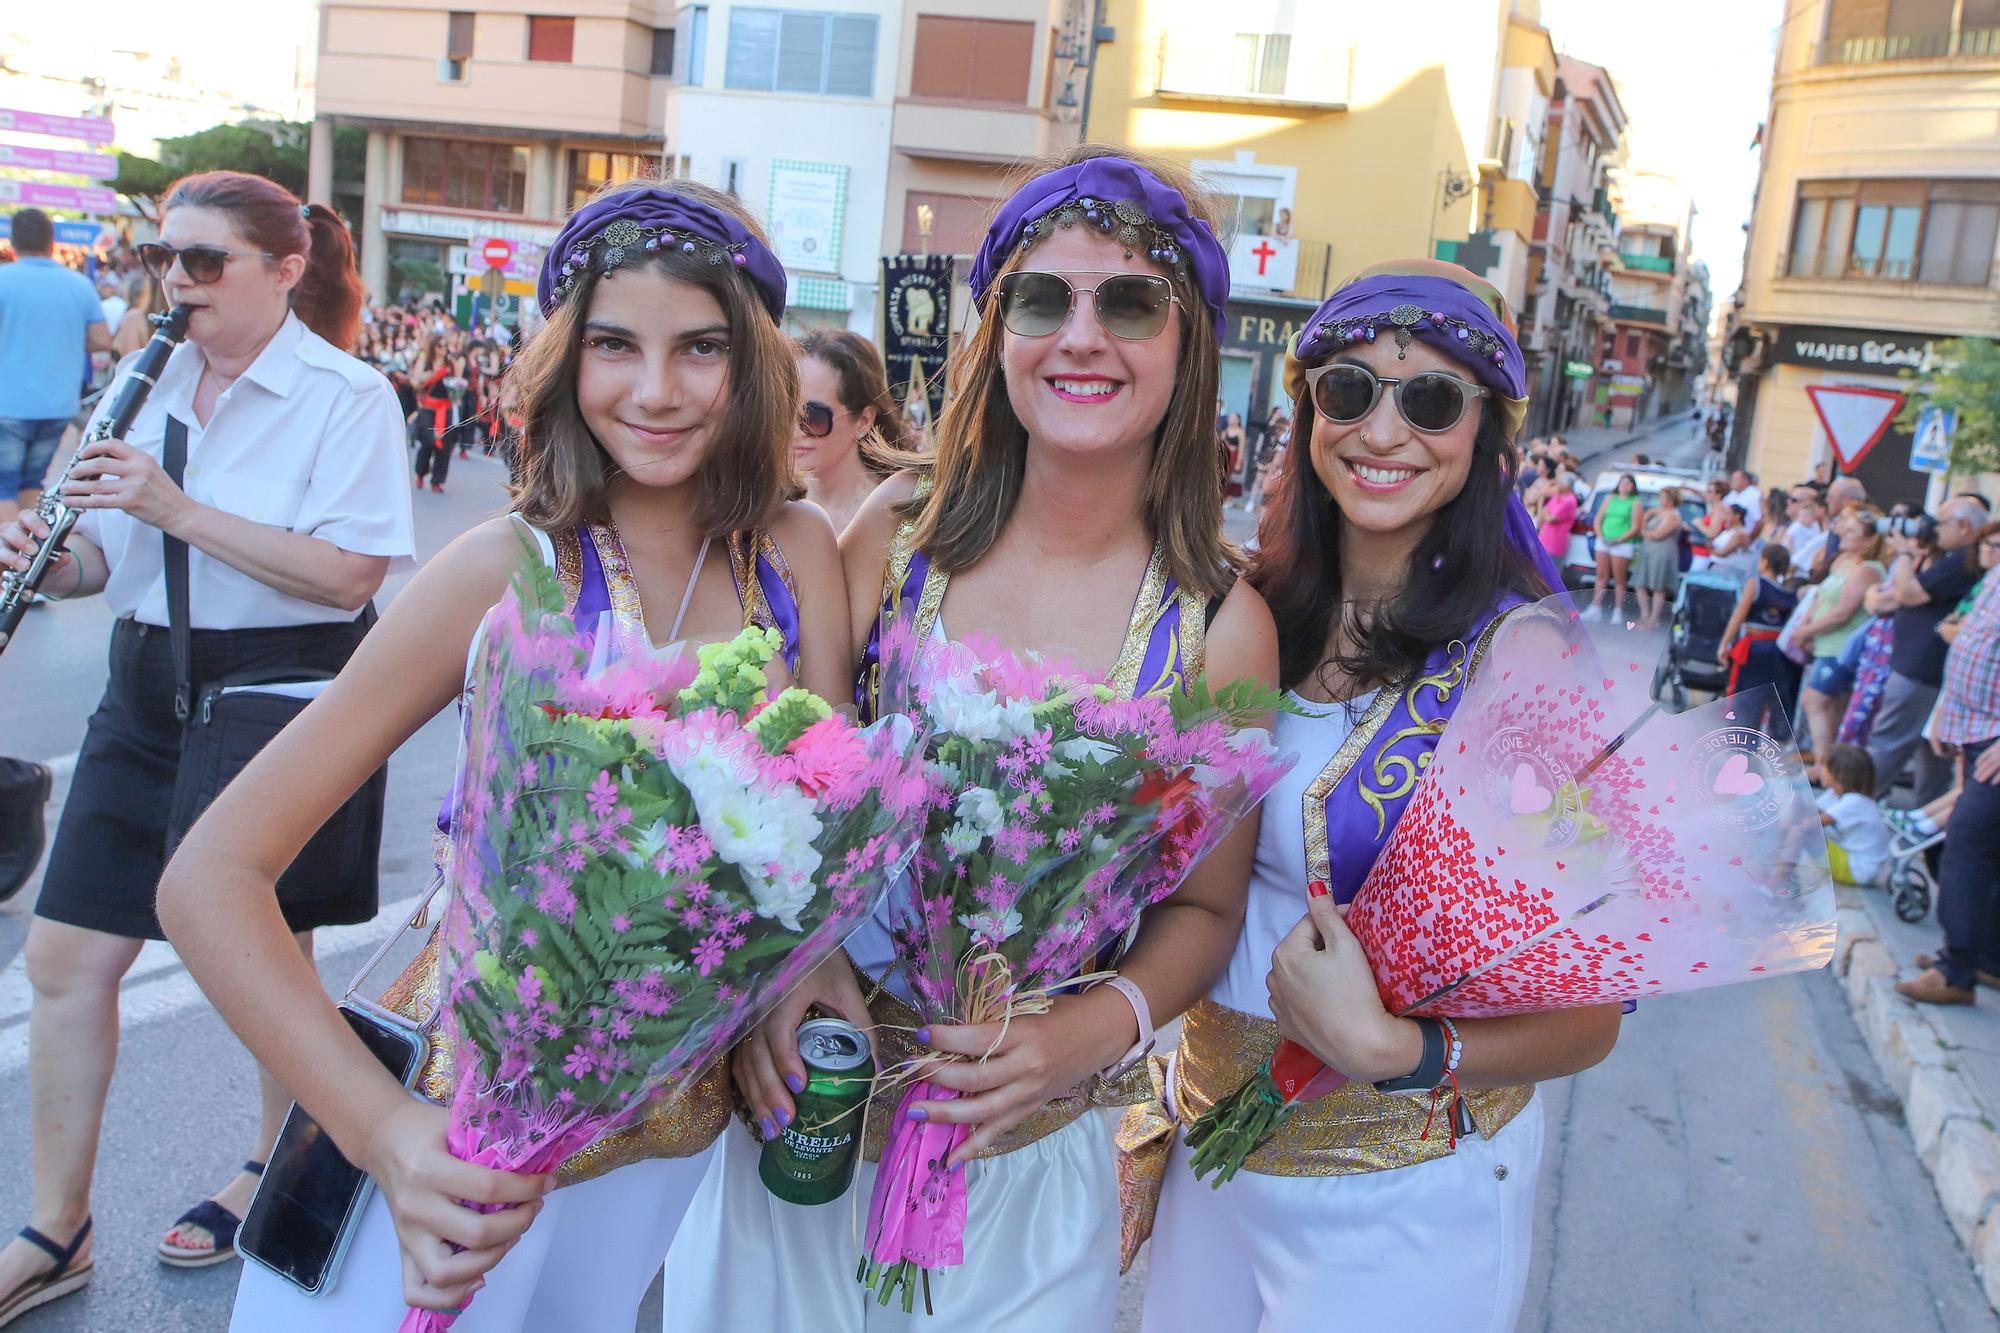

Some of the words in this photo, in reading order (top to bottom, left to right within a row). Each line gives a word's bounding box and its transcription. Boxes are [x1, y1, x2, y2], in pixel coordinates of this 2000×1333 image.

[1238, 315, 1306, 346] FRA
[1795, 340, 1860, 362] VIAJES
[1496, 737, 1523, 754] LOVE
[1533, 745, 1568, 785] AMOR
[780, 1126, 852, 1148] STRELLA
[784, 1137, 795, 1148] DE
[795, 1143, 834, 1154] LEVANTE
